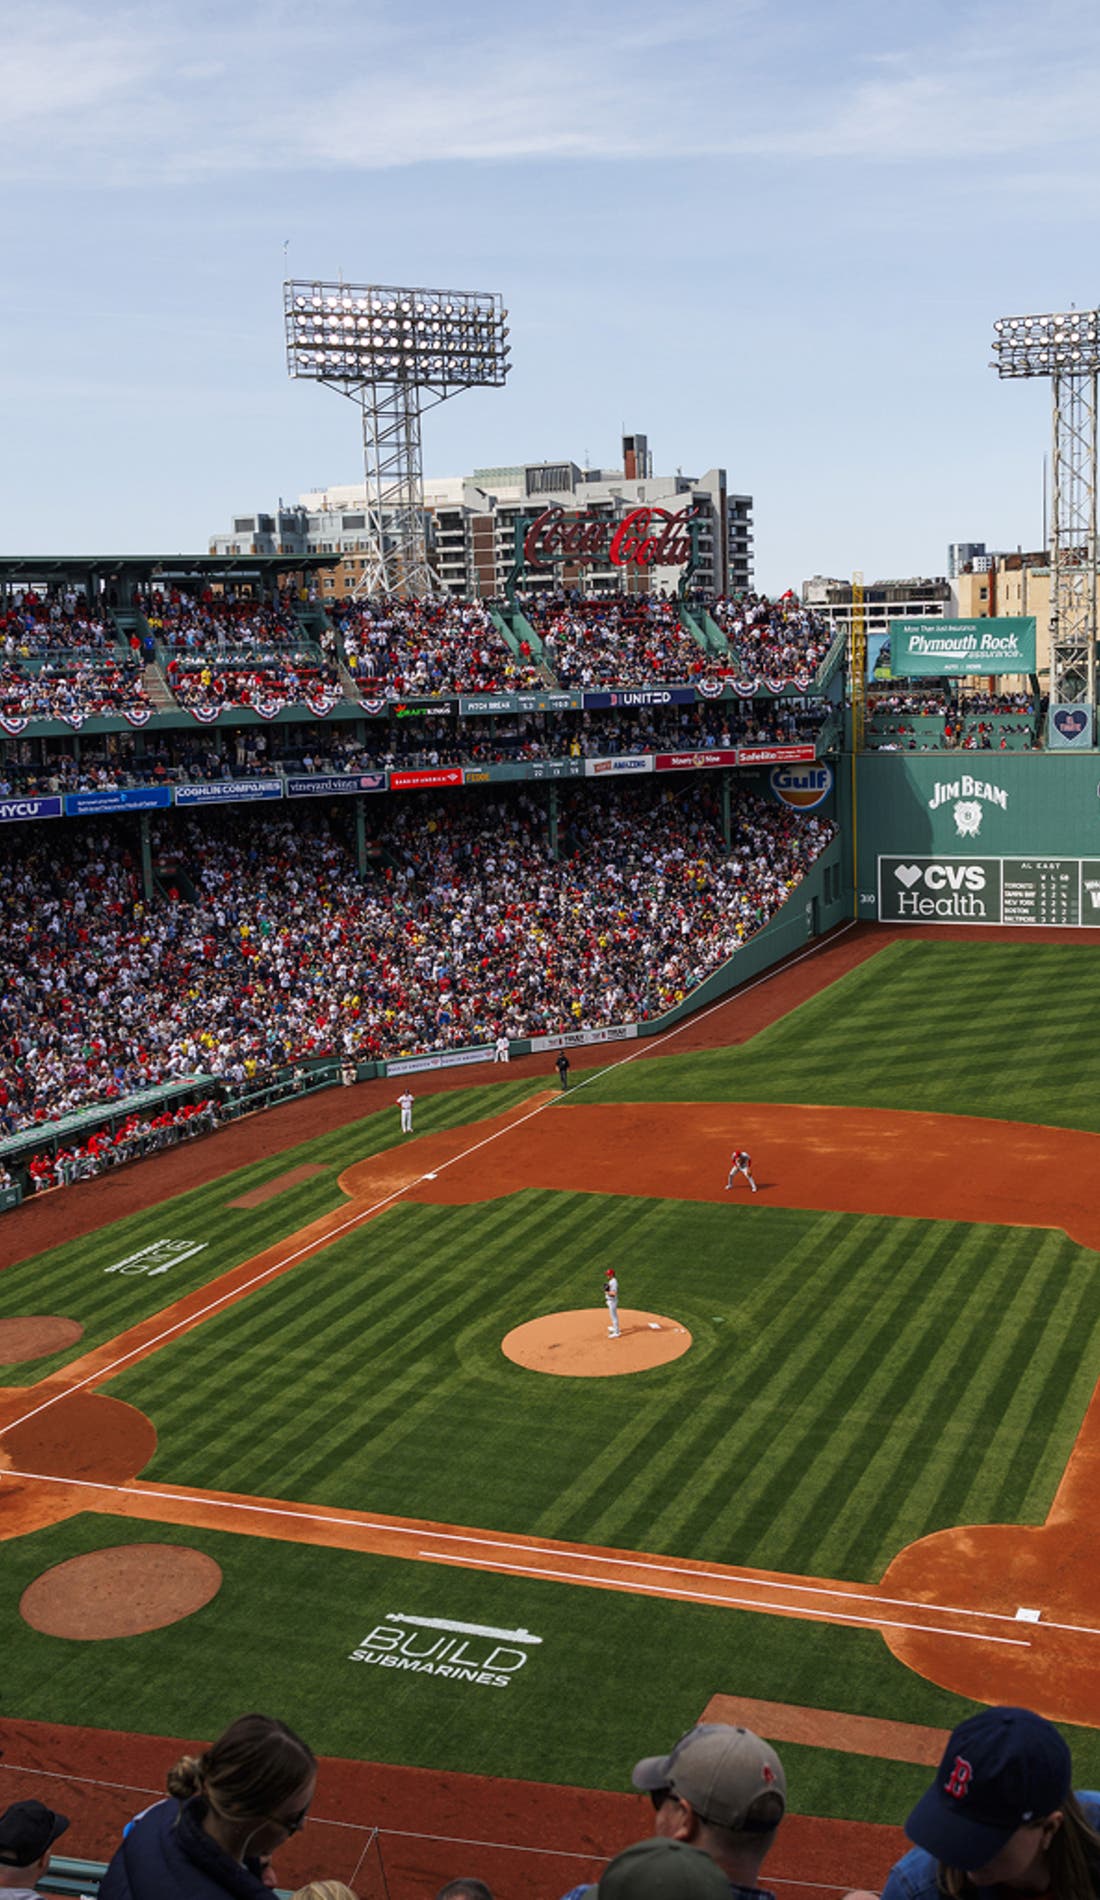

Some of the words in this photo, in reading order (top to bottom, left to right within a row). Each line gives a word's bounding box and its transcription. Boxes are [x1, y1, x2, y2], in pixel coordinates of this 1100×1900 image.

[908, 635, 978, 652] Plymouth
[980, 634, 1019, 650] Rock
[623, 692, 671, 705] UNITED
[739, 751, 777, 760] Safelite
[289, 780, 332, 794] vineyard
[773, 769, 828, 789] Gulf
[928, 782, 960, 810] JIM
[961, 775, 1008, 810] BEAM
[924, 864, 987, 891] CVS
[898, 891, 987, 917] Health
[359, 1625, 528, 1673] BUILD
[347, 1649, 512, 1688] SUBMARINES
[944, 1755, 973, 1799] B
